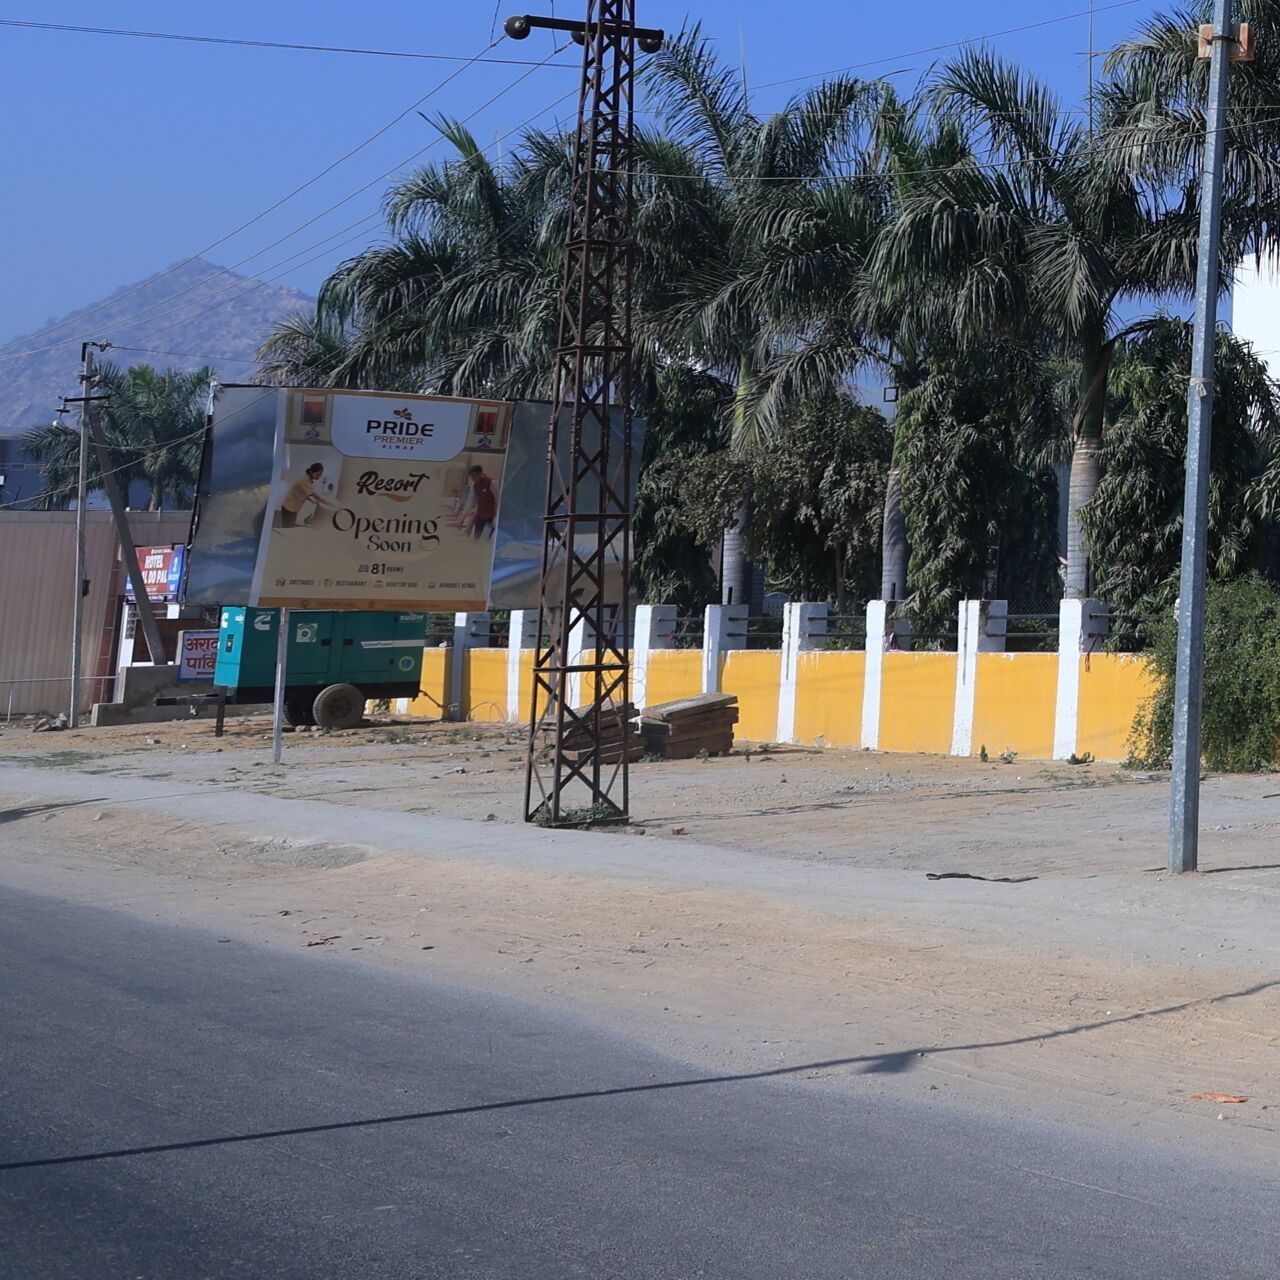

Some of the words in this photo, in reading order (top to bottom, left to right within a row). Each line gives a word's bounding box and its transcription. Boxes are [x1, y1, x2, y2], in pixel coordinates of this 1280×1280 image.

[366, 420, 435, 437] PRIDE
[373, 435, 424, 446] PREMIER
[356, 471, 430, 496] Resort
[332, 508, 441, 552] Opening
[367, 534, 411, 552] Soon
[145, 555, 164, 569] HOTEL
[371, 563, 385, 575] 81
